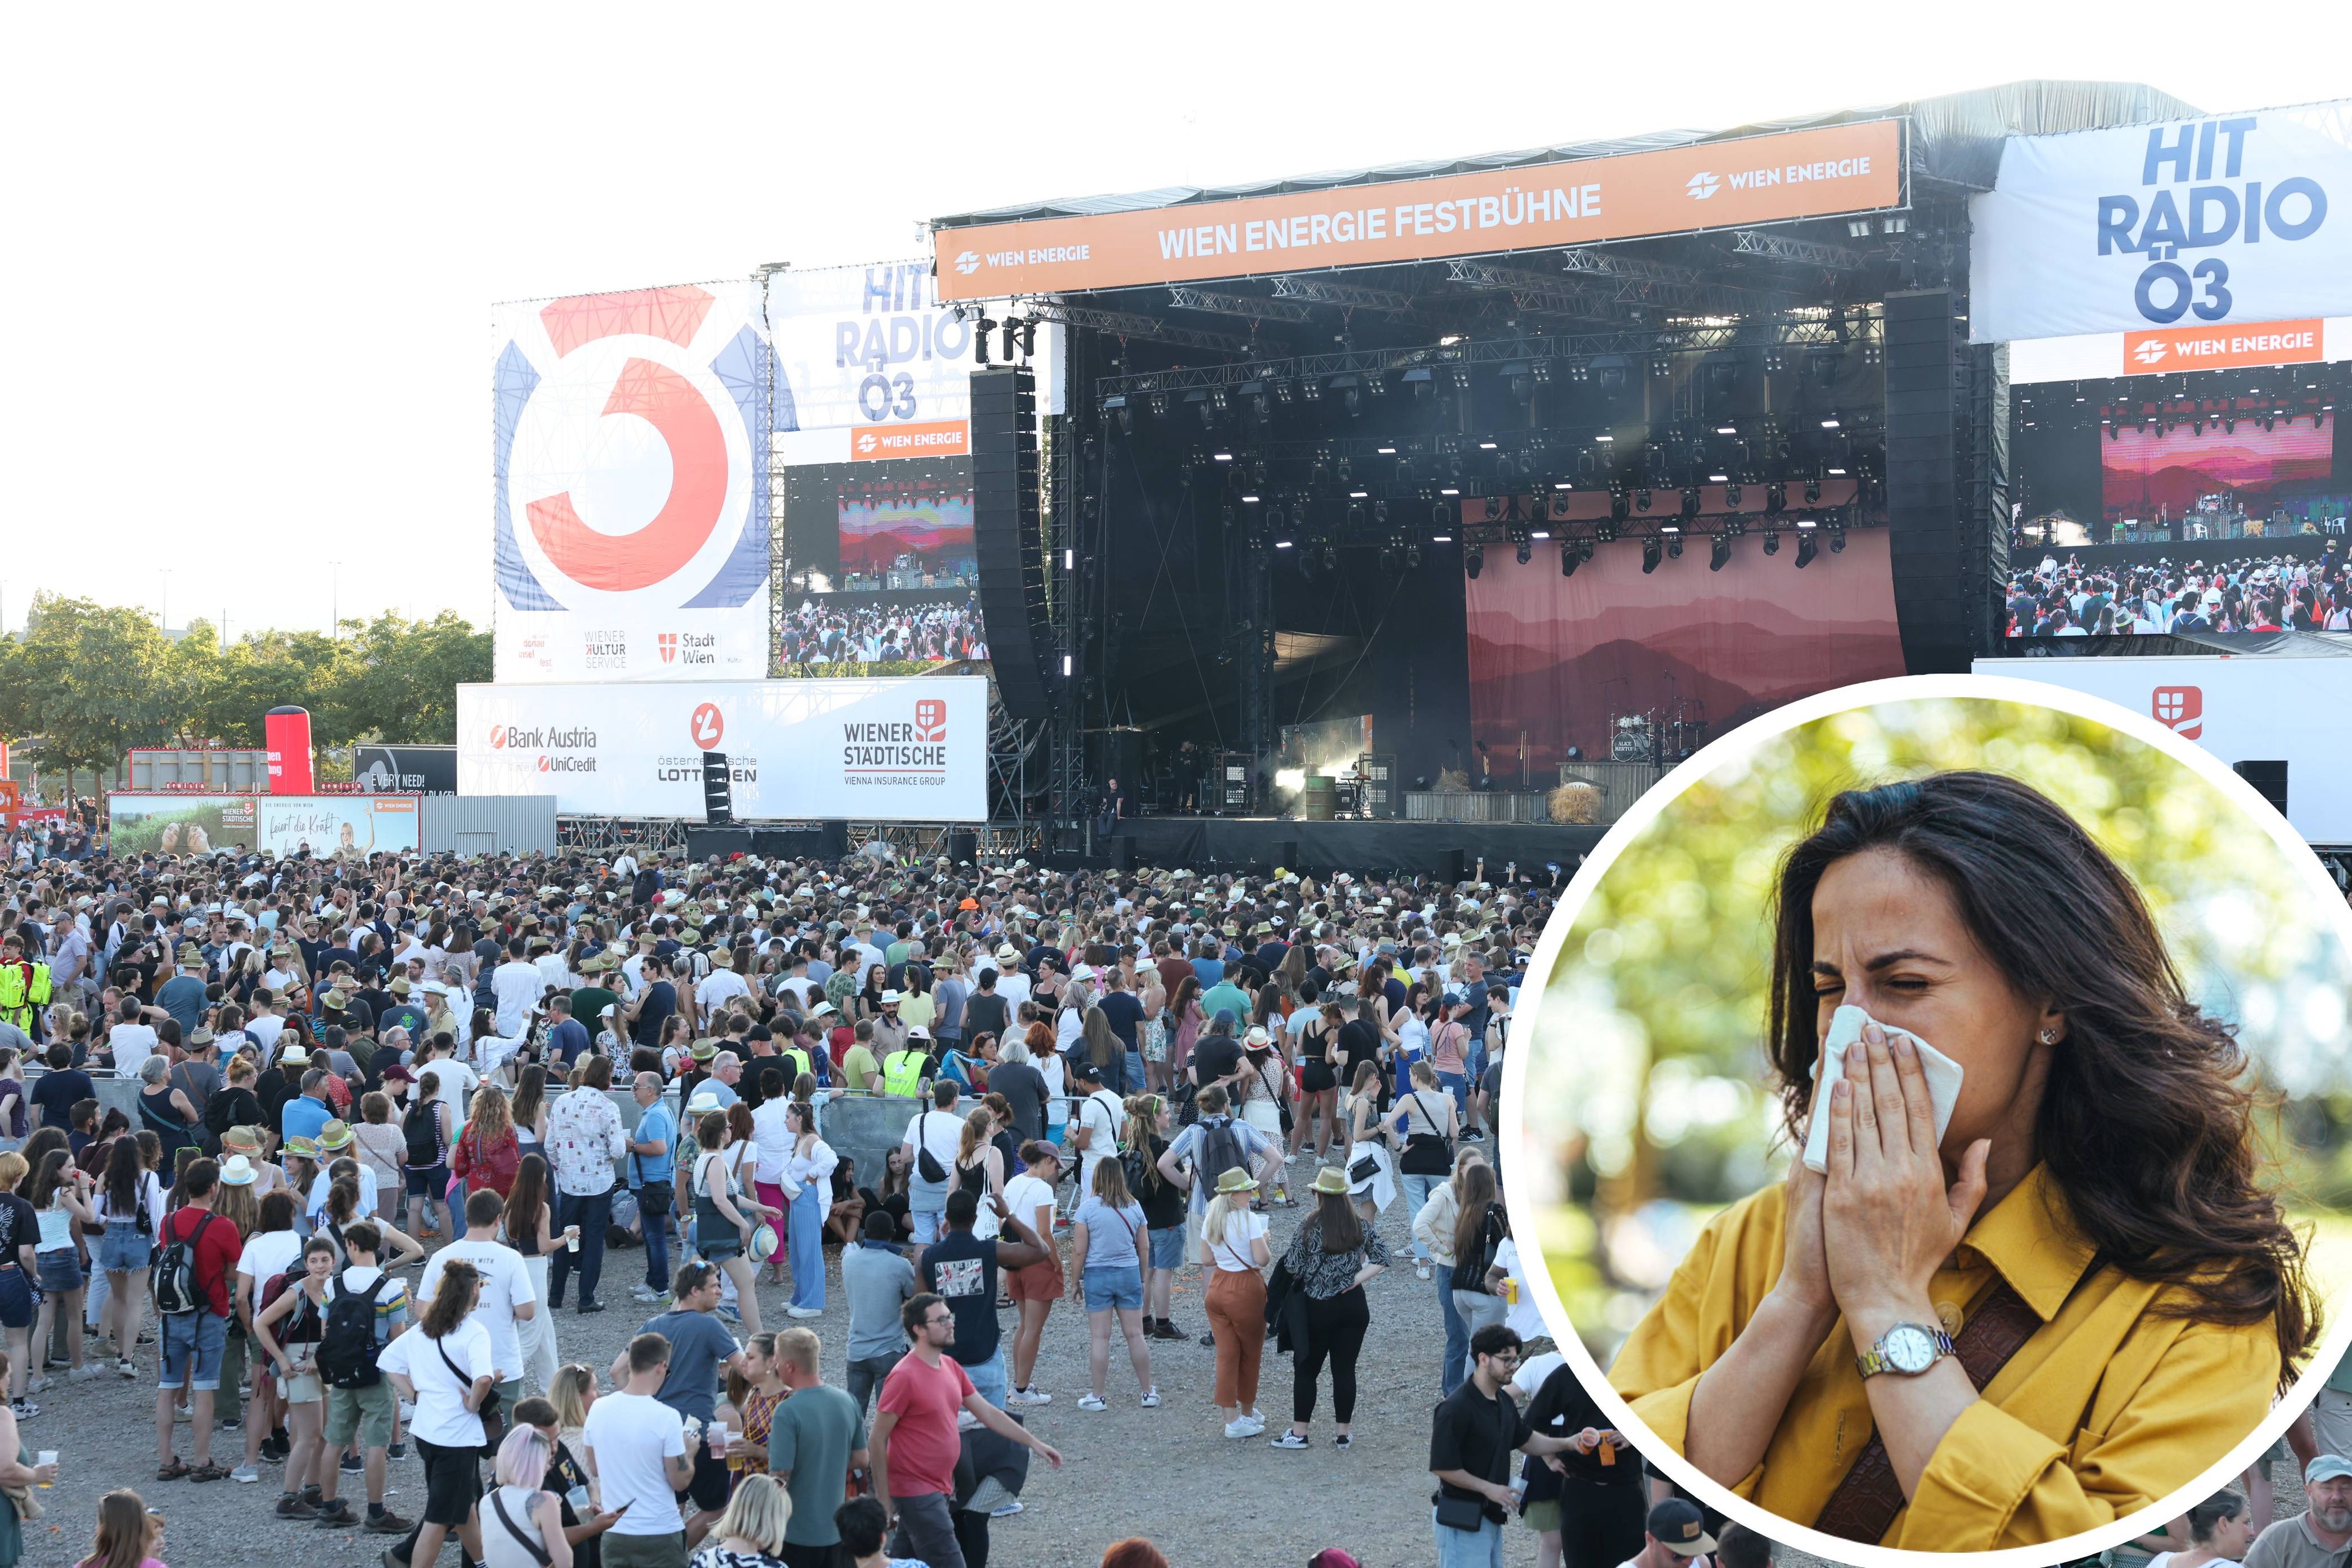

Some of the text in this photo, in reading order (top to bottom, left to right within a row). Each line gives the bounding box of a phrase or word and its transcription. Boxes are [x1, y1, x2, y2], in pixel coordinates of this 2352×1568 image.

[2142, 117, 2257, 186] HIT
[1728, 156, 1870, 190] WIEN ENERGIE
[1158, 183, 1601, 259] WIEN ENERGIE FESTBÜHNE
[2098, 177, 2328, 256] RADIO
[985, 245, 1090, 268] WIEN ENERGIE
[863, 263, 929, 314] HIT
[2134, 243, 2233, 324] Ö3
[836, 312, 971, 368] RADIO
[2175, 332, 2314, 357] WIEN ENERGIE
[858, 357, 917, 422] Ö3
[881, 432, 963, 447] WIEN ENERGIE
[523, 639, 544, 647] donau
[584, 631, 625, 642] WIENER
[683, 633, 715, 647] Stadt
[519, 649, 534, 658] insel
[586, 644, 626, 655] KULTUR
[683, 650, 715, 664] Wien
[586, 657, 626, 668] SERVICE
[508, 726, 596, 748] Bank Austria
[844, 723, 913, 742] WIENER
[551, 756, 596, 772] UniCredit
[658, 755, 757, 765] österresche
[844, 746, 946, 765] STÄDTISCHE
[371, 774, 425, 787] EVERY NEED!
[844, 777, 946, 785] VIENNA INSURANCE GROUP
[270, 811, 340, 840] feiert die Kraft
[282, 838, 295, 857] der
